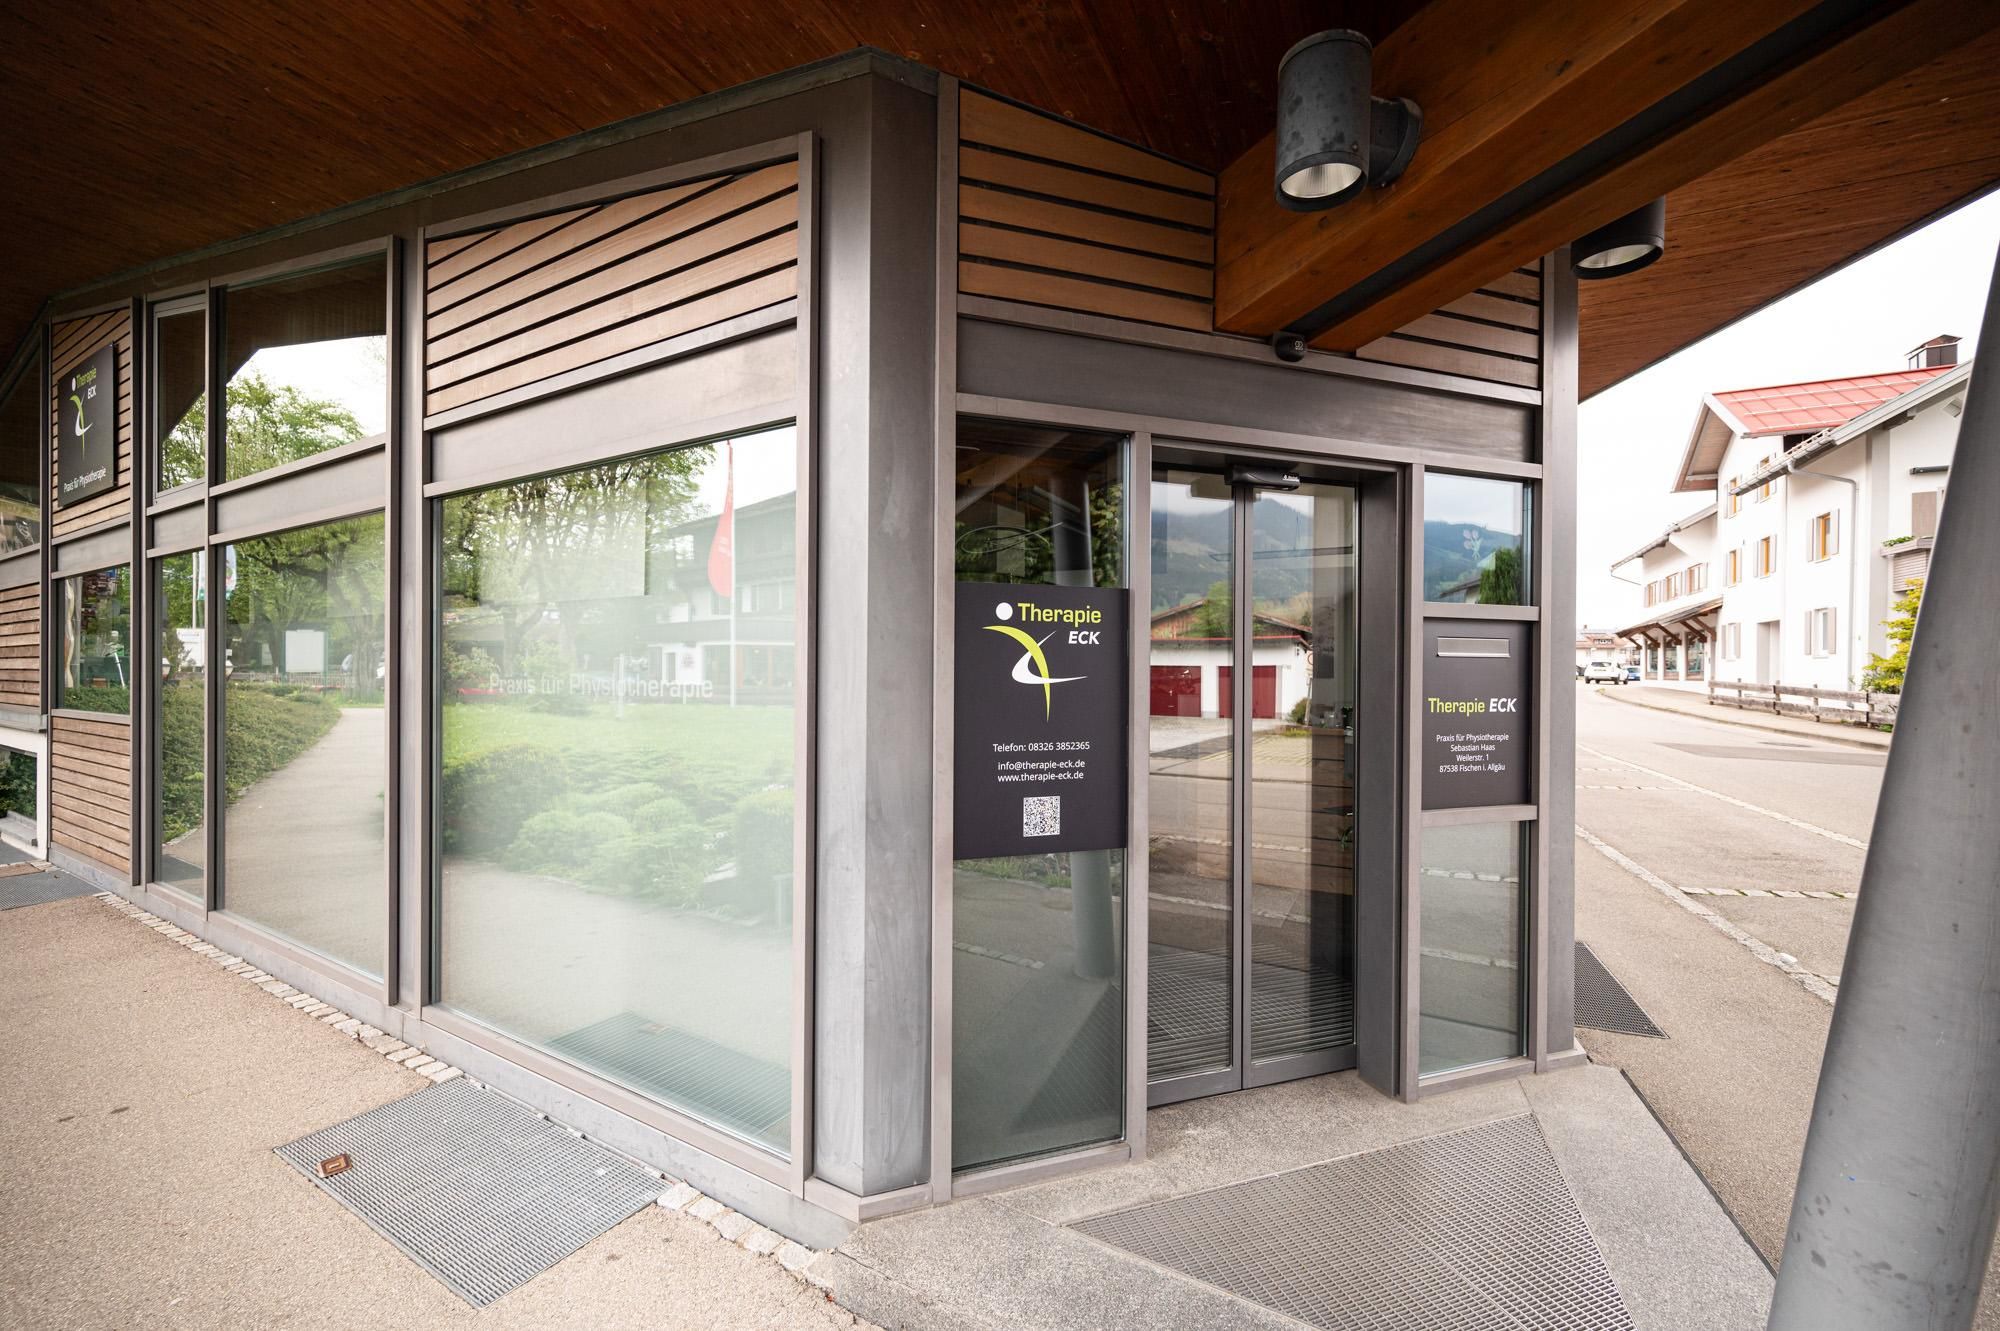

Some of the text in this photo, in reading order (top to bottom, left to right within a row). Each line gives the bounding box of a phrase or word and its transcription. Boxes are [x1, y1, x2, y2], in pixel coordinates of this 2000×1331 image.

[76, 367, 96, 389] Therapie
[87, 385, 97, 399] ECK
[1018, 602, 1102, 627] Therapie
[1067, 630, 1101, 645] ECK
[488, 673, 536, 695] Praxis
[569, 673, 713, 704] Physiotherapie
[1428, 697, 1518, 716] Therapie ECK
[1436, 733, 1509, 743] Praxis für Physiotherapie
[992, 741, 1090, 752] Telefon: 08326 3852365
[1450, 744, 1480, 752] Sebastian
[1456, 754, 1485, 762] Weilerstr.
[997, 760, 1086, 771] info@therapie-eck.de
[1439, 764, 1459, 773] 87538
[1459, 764, 1482, 772] Fischen
[1487, 762, 1506, 773] Allgäu
[997, 771, 1084, 783] www.therapie-eck.de
